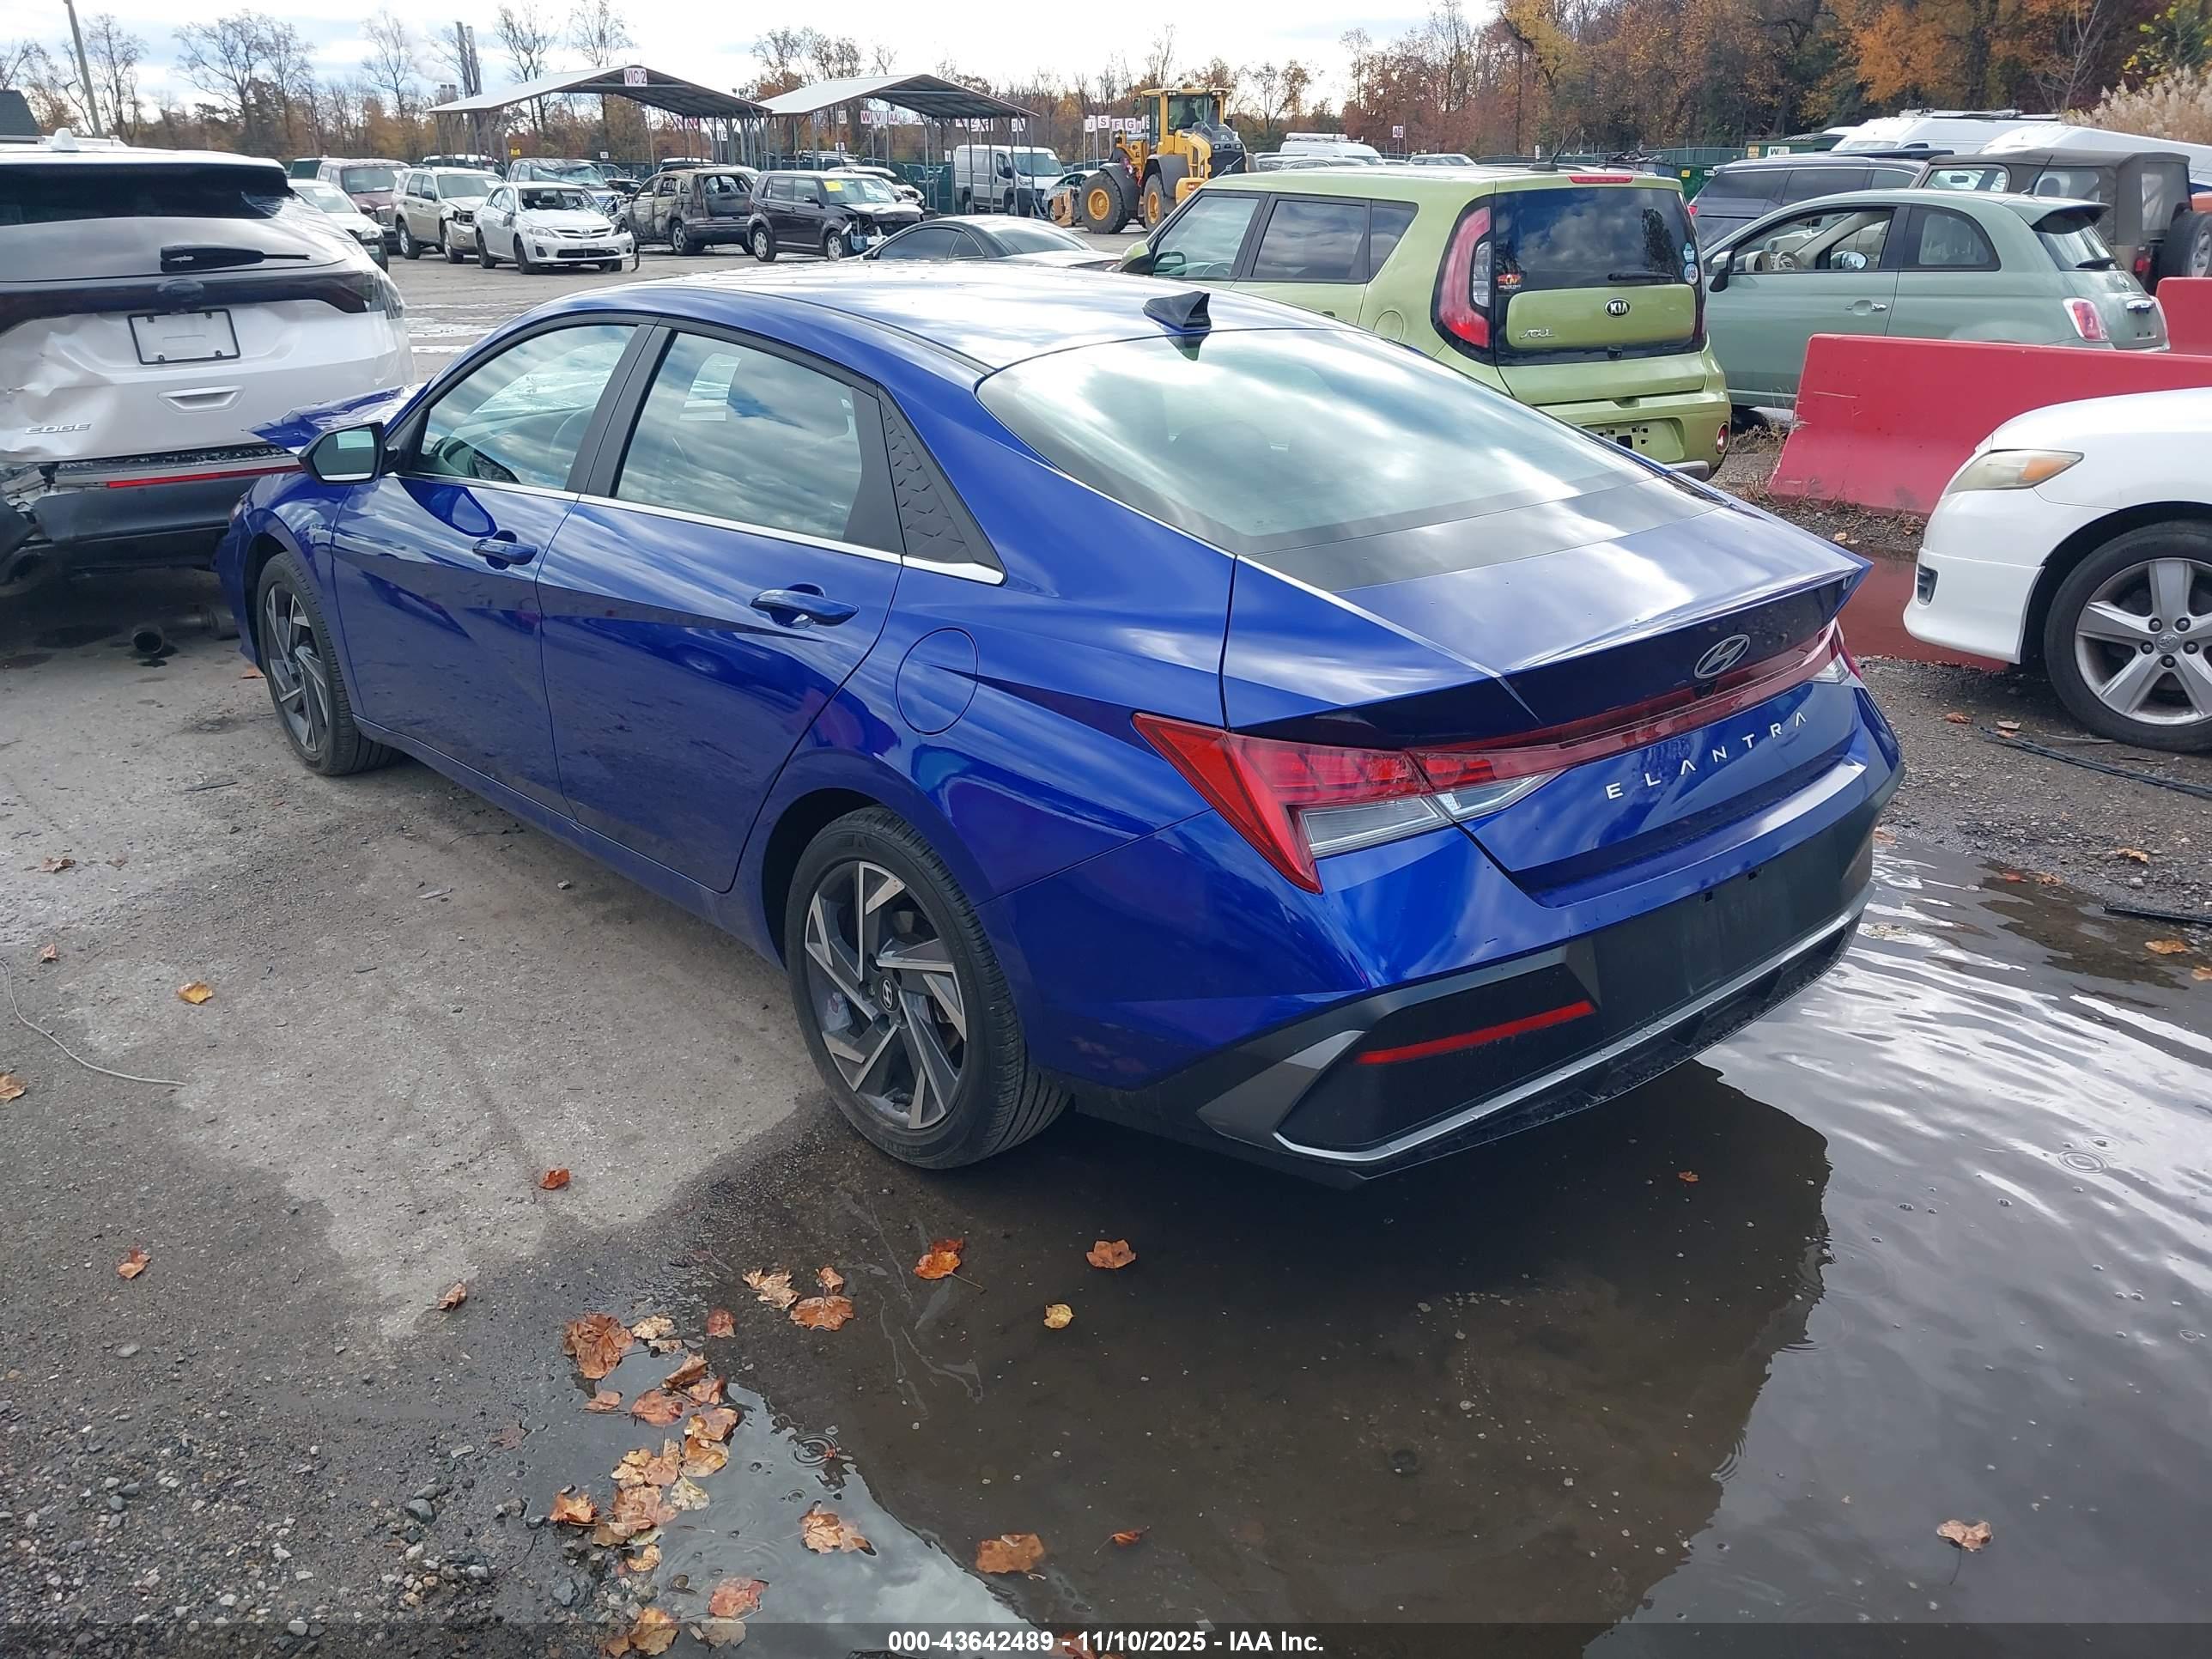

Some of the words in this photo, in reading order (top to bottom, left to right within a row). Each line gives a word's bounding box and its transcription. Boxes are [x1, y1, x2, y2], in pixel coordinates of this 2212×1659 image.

[625, 70, 640, 83] VIC
[641, 70, 647, 83] 2
[861, 112, 871, 122] W
[876, 112, 882, 121] V
[889, 113, 898, 123] AA
[1100, 118, 1107, 126] S
[1115, 120, 1120, 129] F
[1127, 120, 1133, 129] G
[1610, 302, 1629, 314] KIA
[25, 422, 92, 434] EDGE
[1605, 711, 1808, 800] ELANTRA
